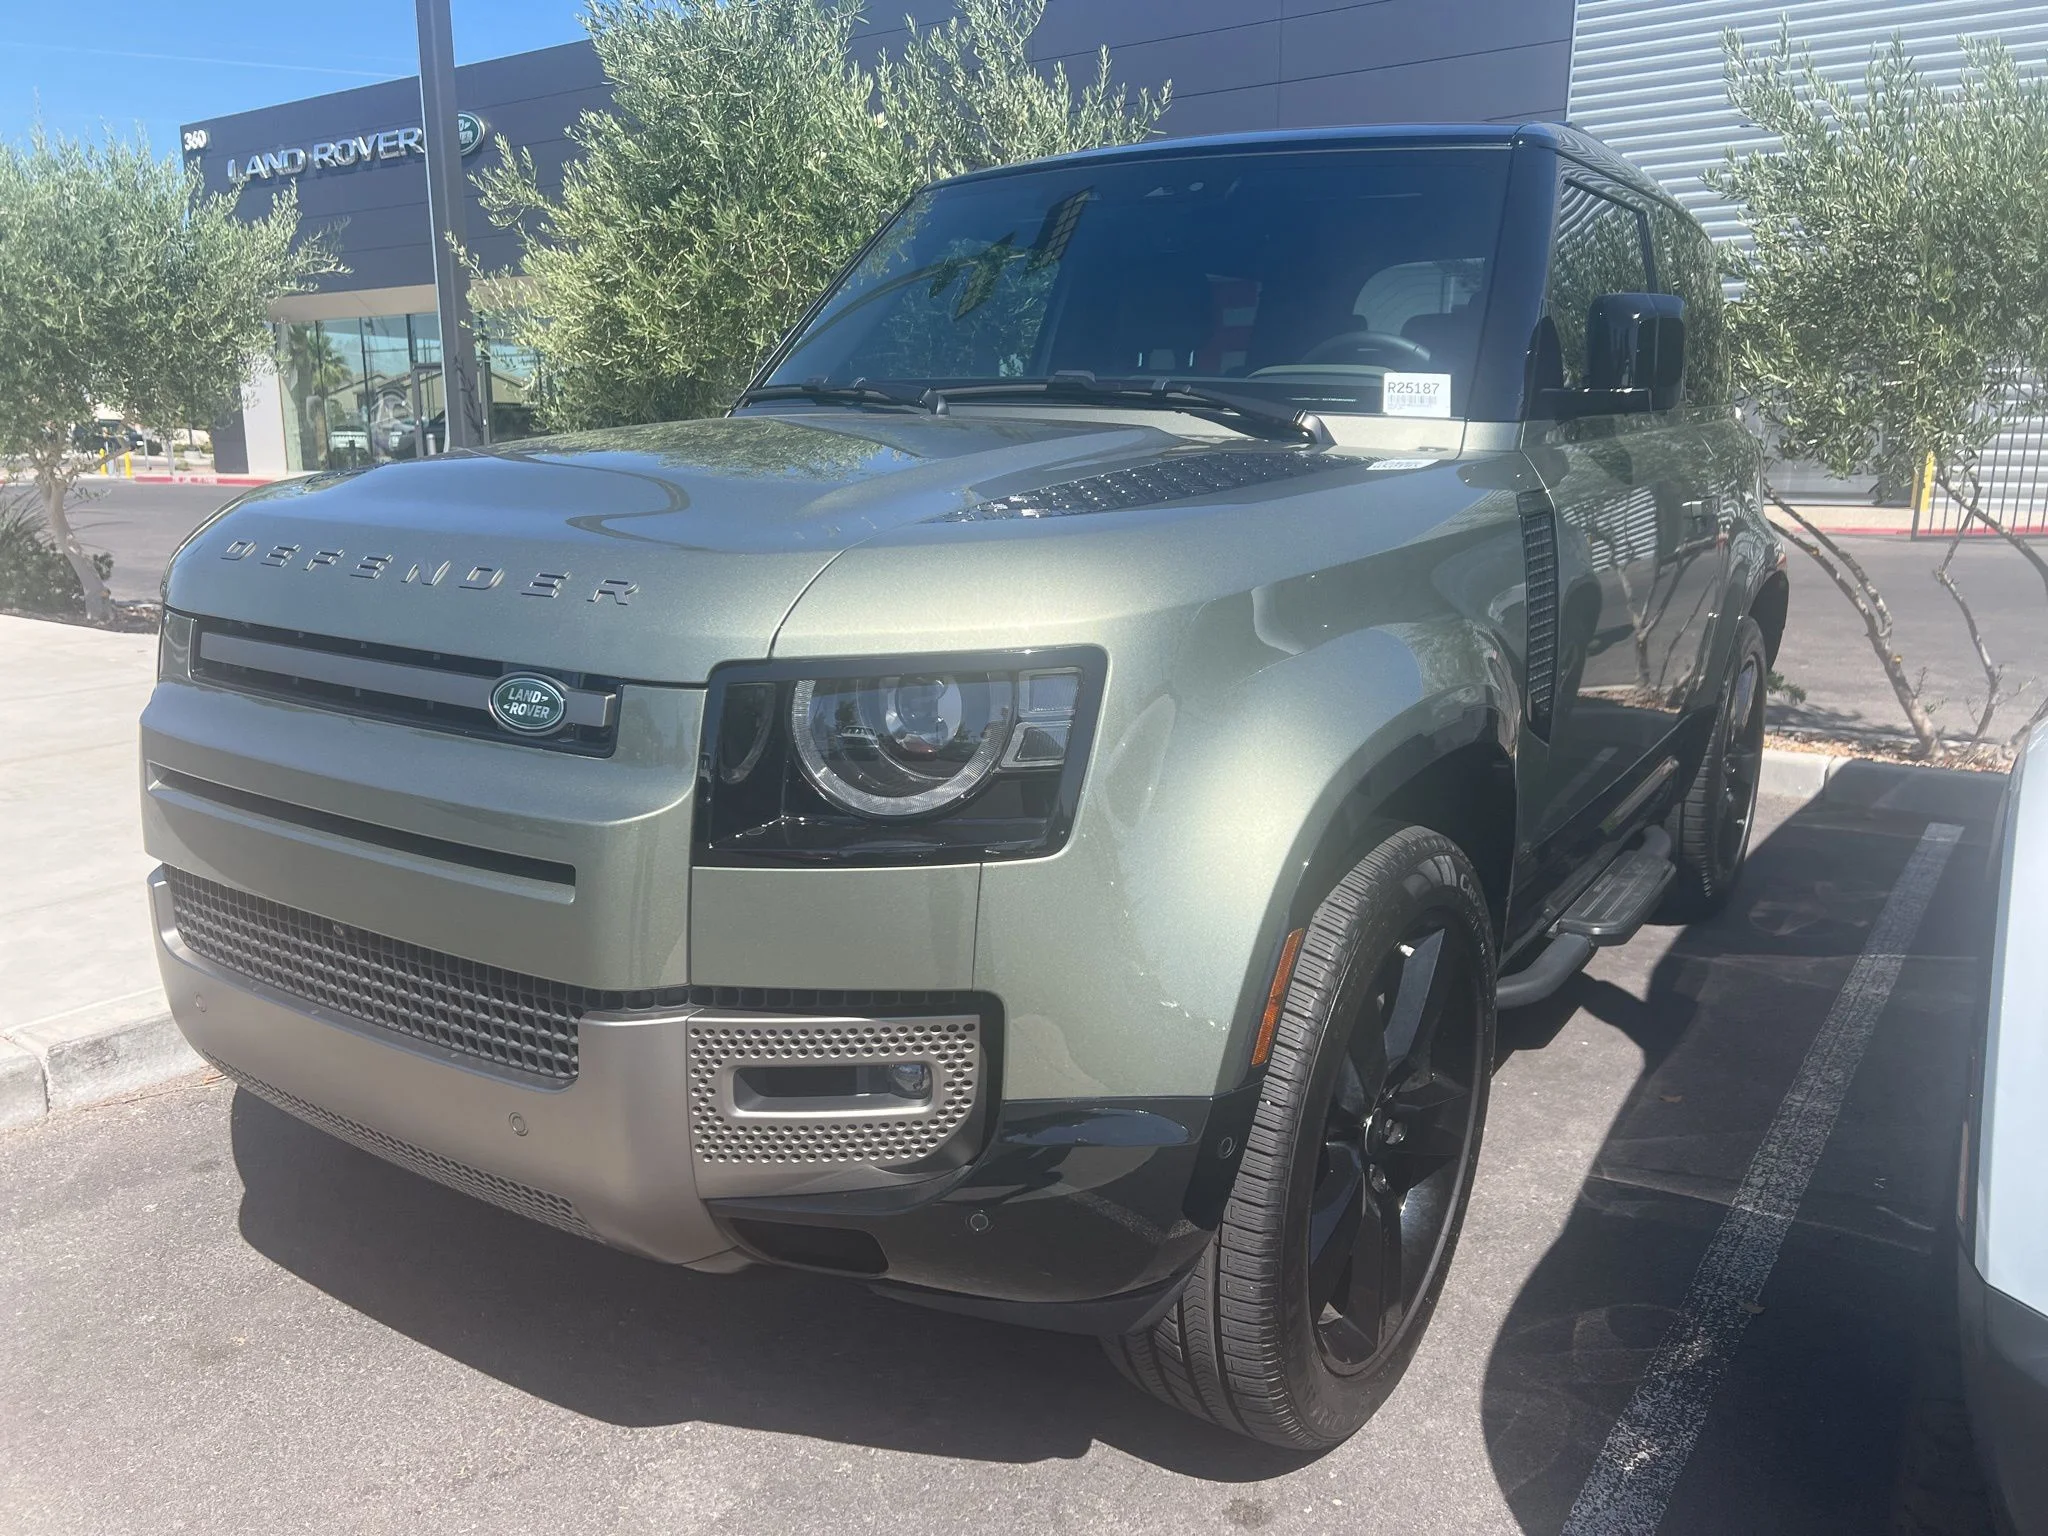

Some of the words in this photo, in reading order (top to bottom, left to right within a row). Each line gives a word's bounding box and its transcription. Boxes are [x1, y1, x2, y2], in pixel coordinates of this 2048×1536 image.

[184, 130, 207, 150] 360
[227, 148, 307, 183] LAND
[313, 127, 426, 169] ROVER
[1387, 382, 1440, 395] R25187
[220, 538, 640, 606] DEFENDER
[508, 688, 542, 704] LAND
[508, 702, 550, 719] ROVER
